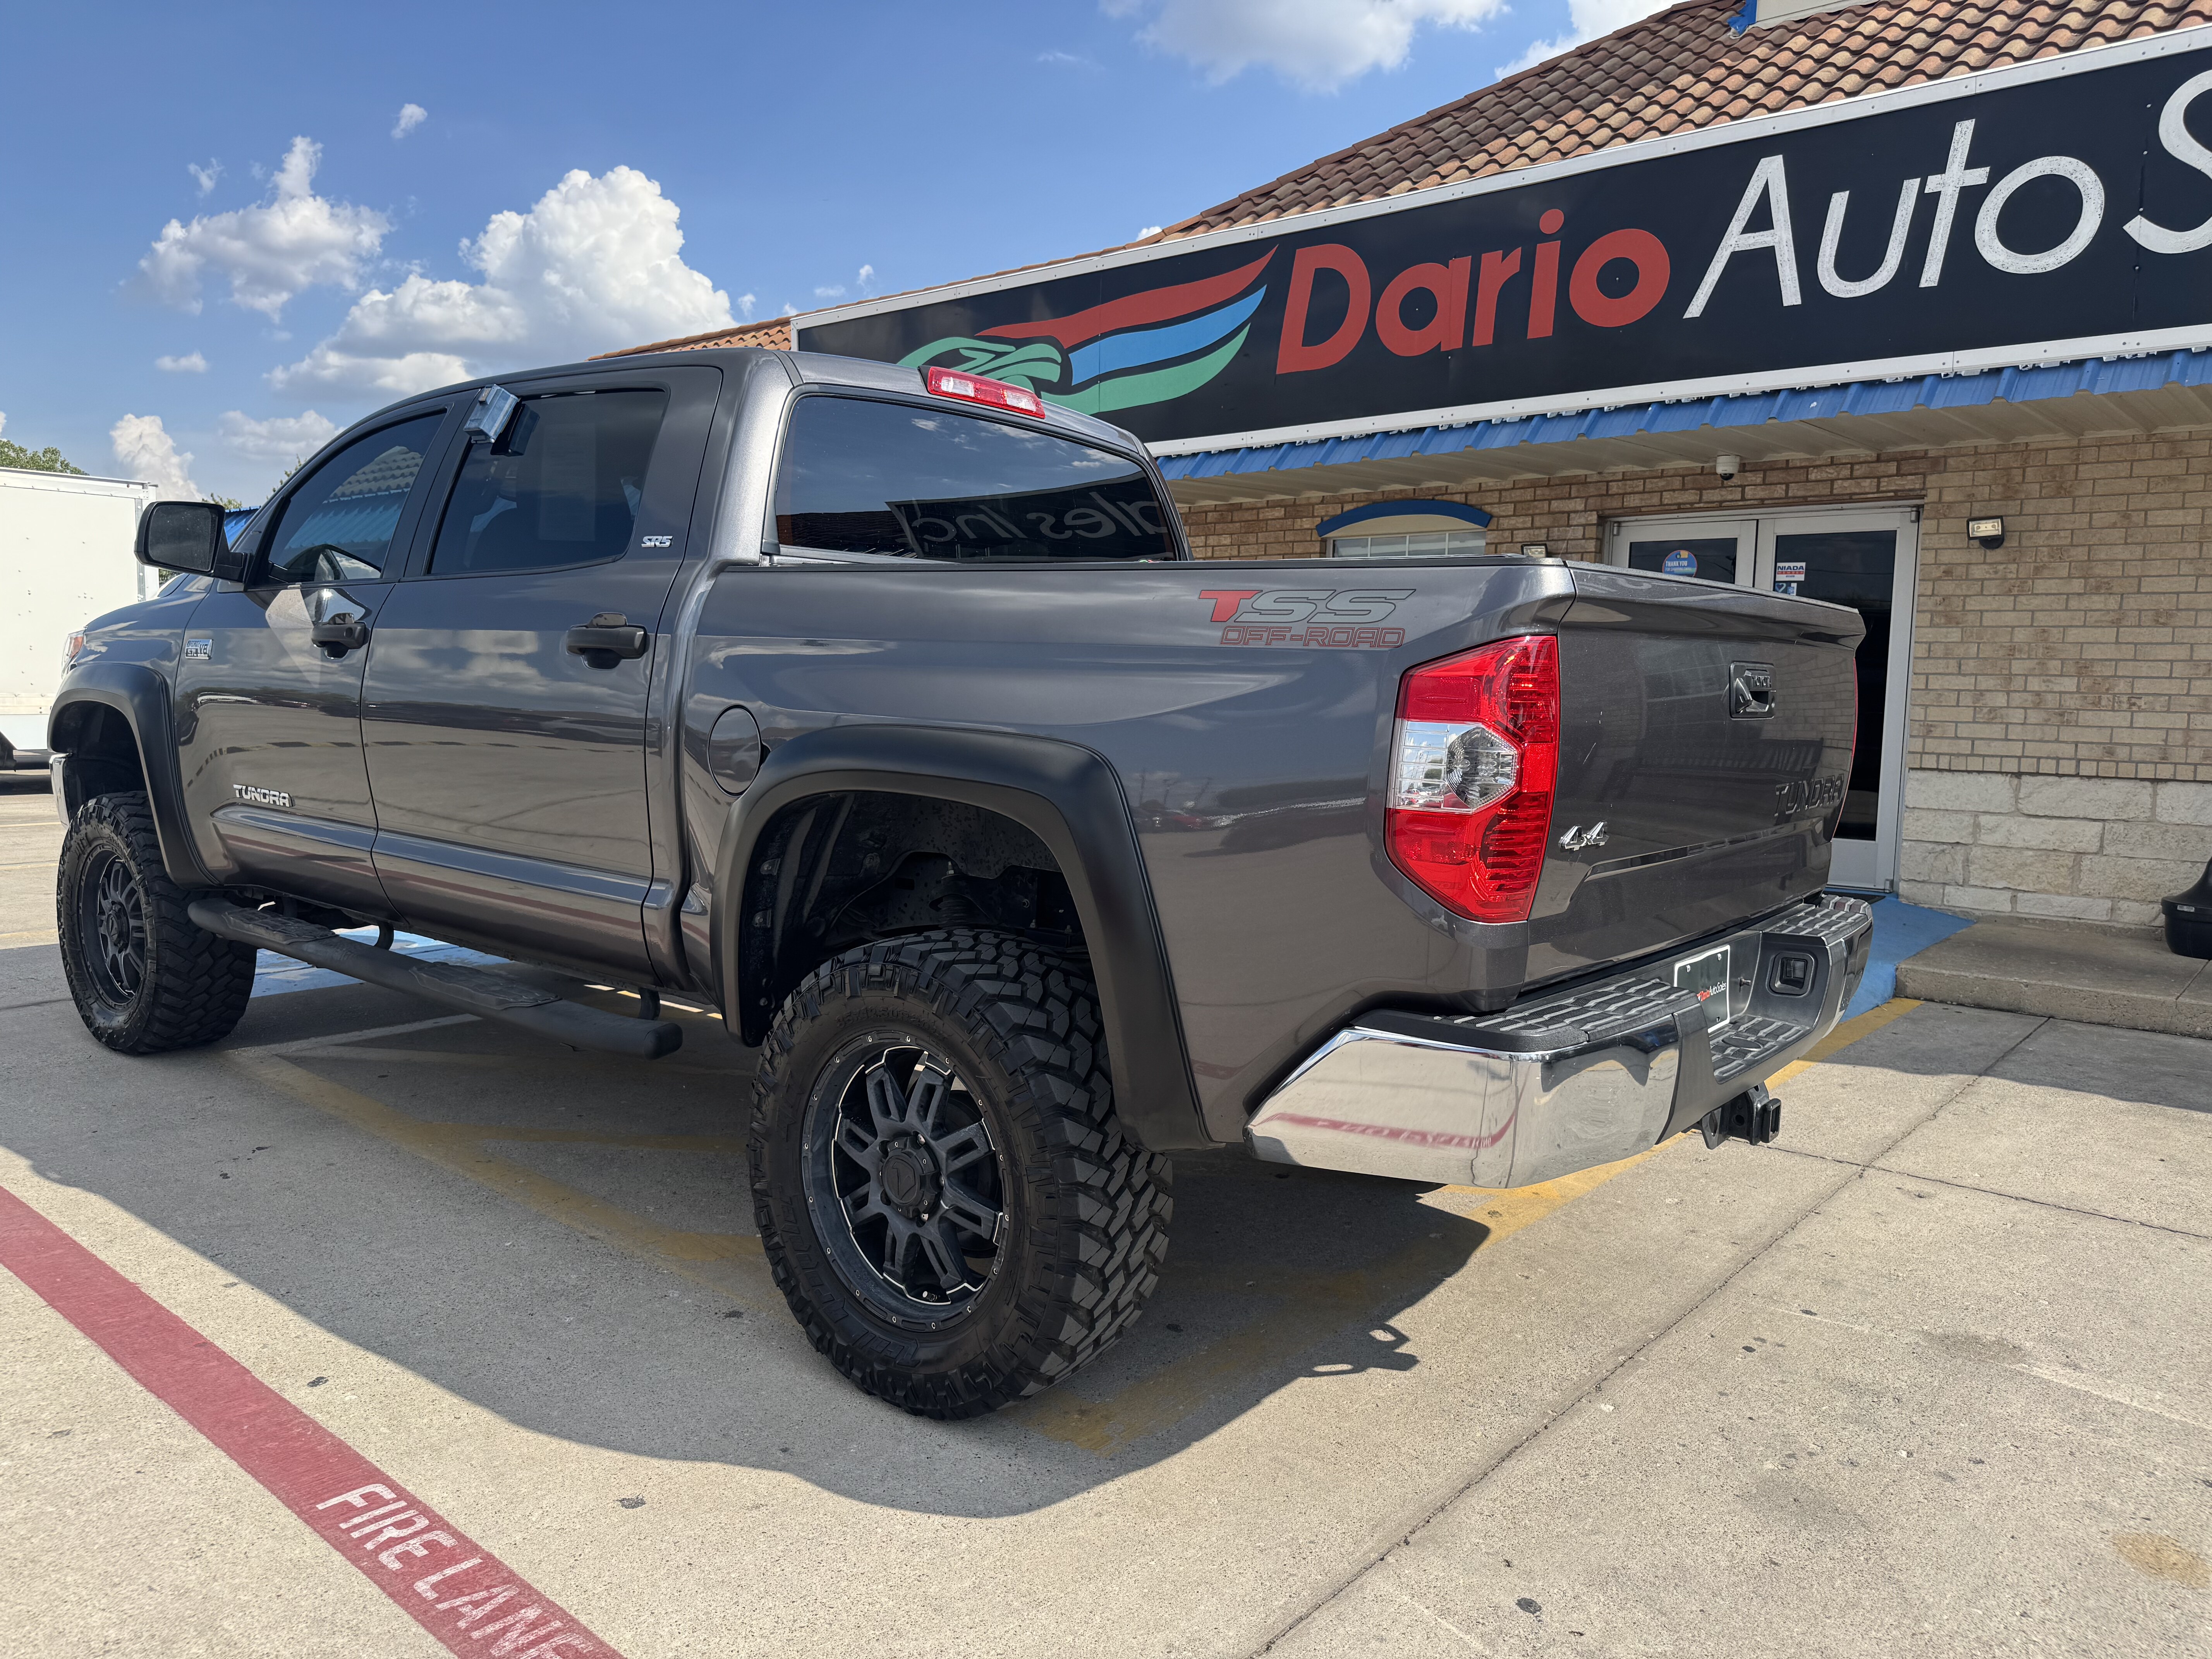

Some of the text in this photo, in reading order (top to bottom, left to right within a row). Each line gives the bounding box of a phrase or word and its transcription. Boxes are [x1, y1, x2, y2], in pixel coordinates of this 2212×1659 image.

[1276, 208, 1670, 374] Dario
[1683, 118, 2104, 318] Auto
[641, 536, 673, 548] SR5
[1198, 589, 1417, 624] TSS
[1220, 625, 1406, 648] OFF-ROAD
[199, 644, 208, 654] V8
[1750, 675, 1772, 688] TOYOT
[233, 784, 290, 807] TUNDRA
[1774, 774, 1844, 818] TUNDRA
[316, 1483, 459, 1571] FIRE
